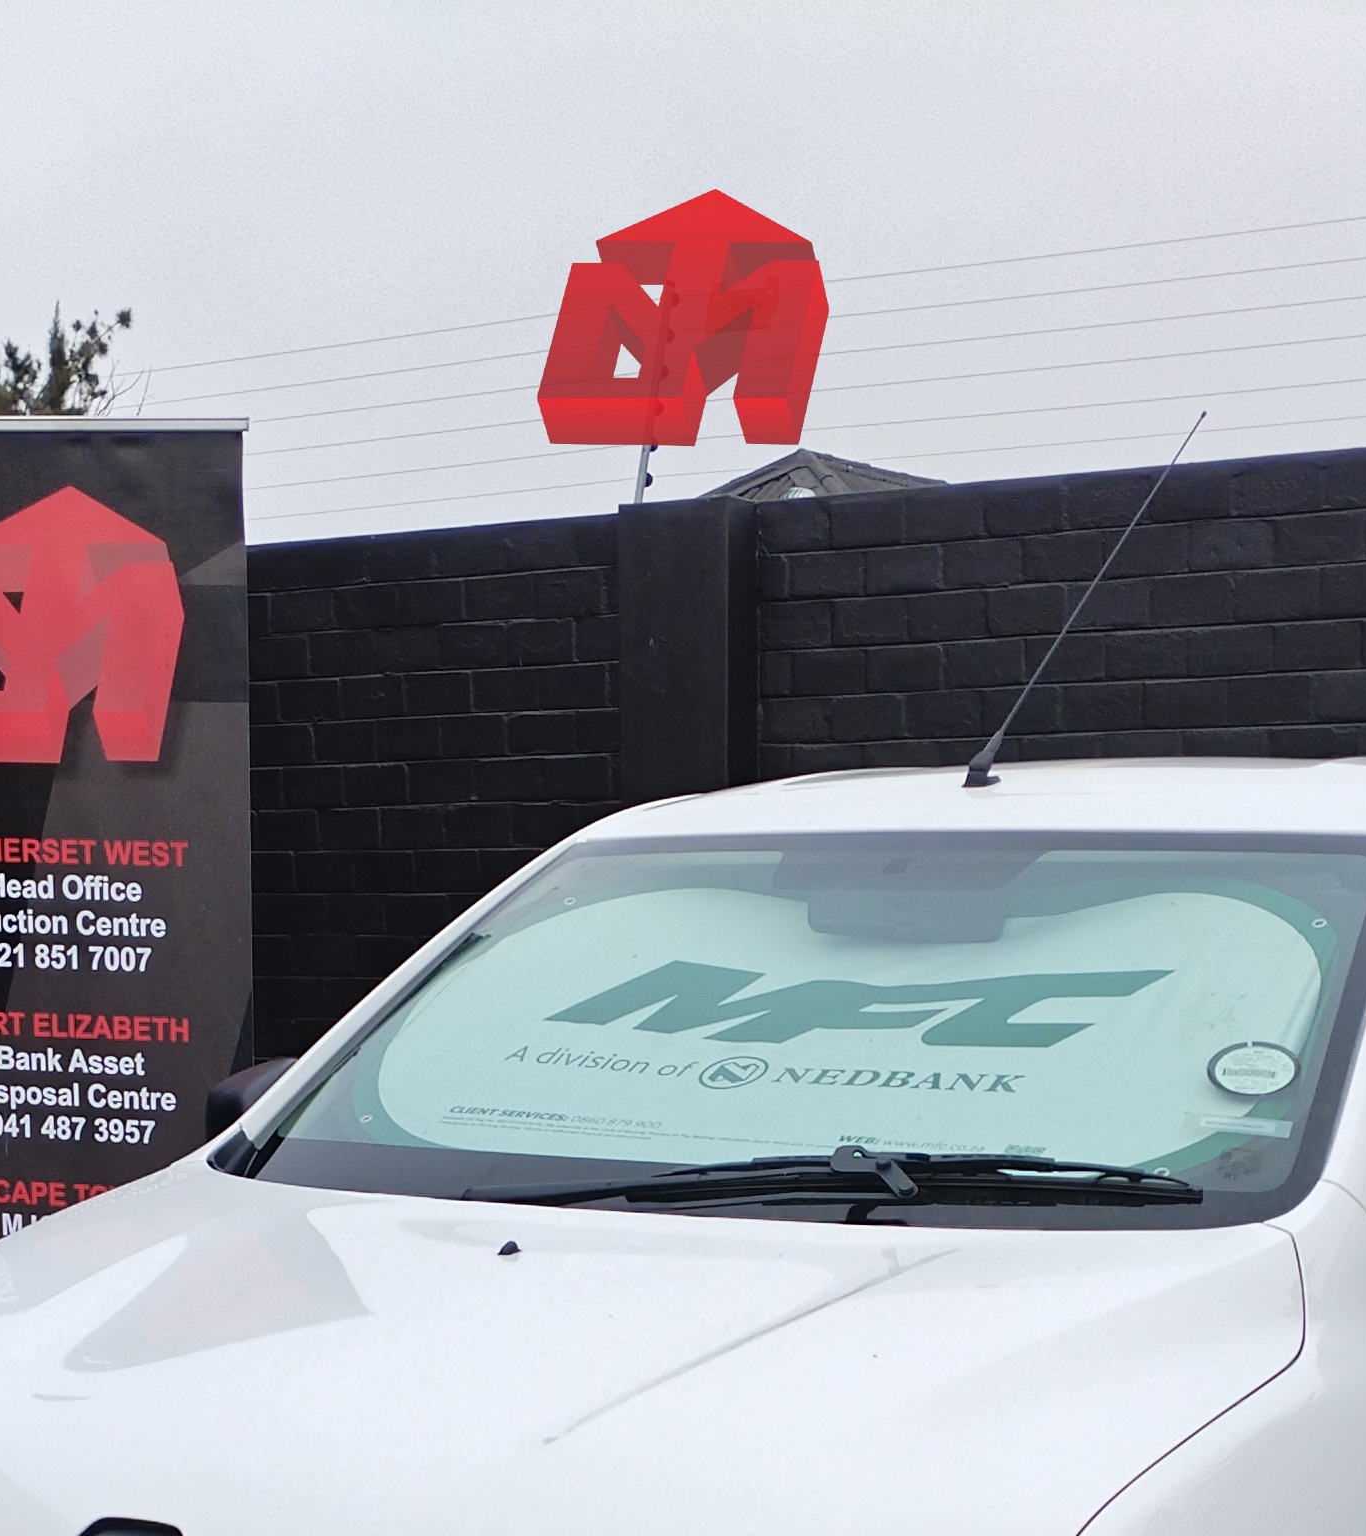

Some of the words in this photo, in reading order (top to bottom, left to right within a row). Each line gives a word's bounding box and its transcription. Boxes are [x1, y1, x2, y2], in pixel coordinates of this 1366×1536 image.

[104, 841, 187, 867] WEST
[62, 875, 142, 902] Office
[76, 910, 166, 937] Centre
[35, 944, 78, 969] 851
[89, 946, 151, 972] 7007
[542, 959, 1176, 1048] MFC
[33, 1012, 189, 1042] ELIZABETH
[69, 1049, 145, 1076] Asset
[504, 1045, 529, 1062] A
[536, 1047, 650, 1076] division
[657, 1060, 699, 1078] of
[771, 1067, 1026, 1094] NEDBANK
[88, 1084, 176, 1111] Centre
[449, 1105, 499, 1116] CLIENT
[498, 1109, 568, 1123] SERVICES:
[41, 1115, 86, 1140] 487
[94, 1118, 155, 1144] 3957
